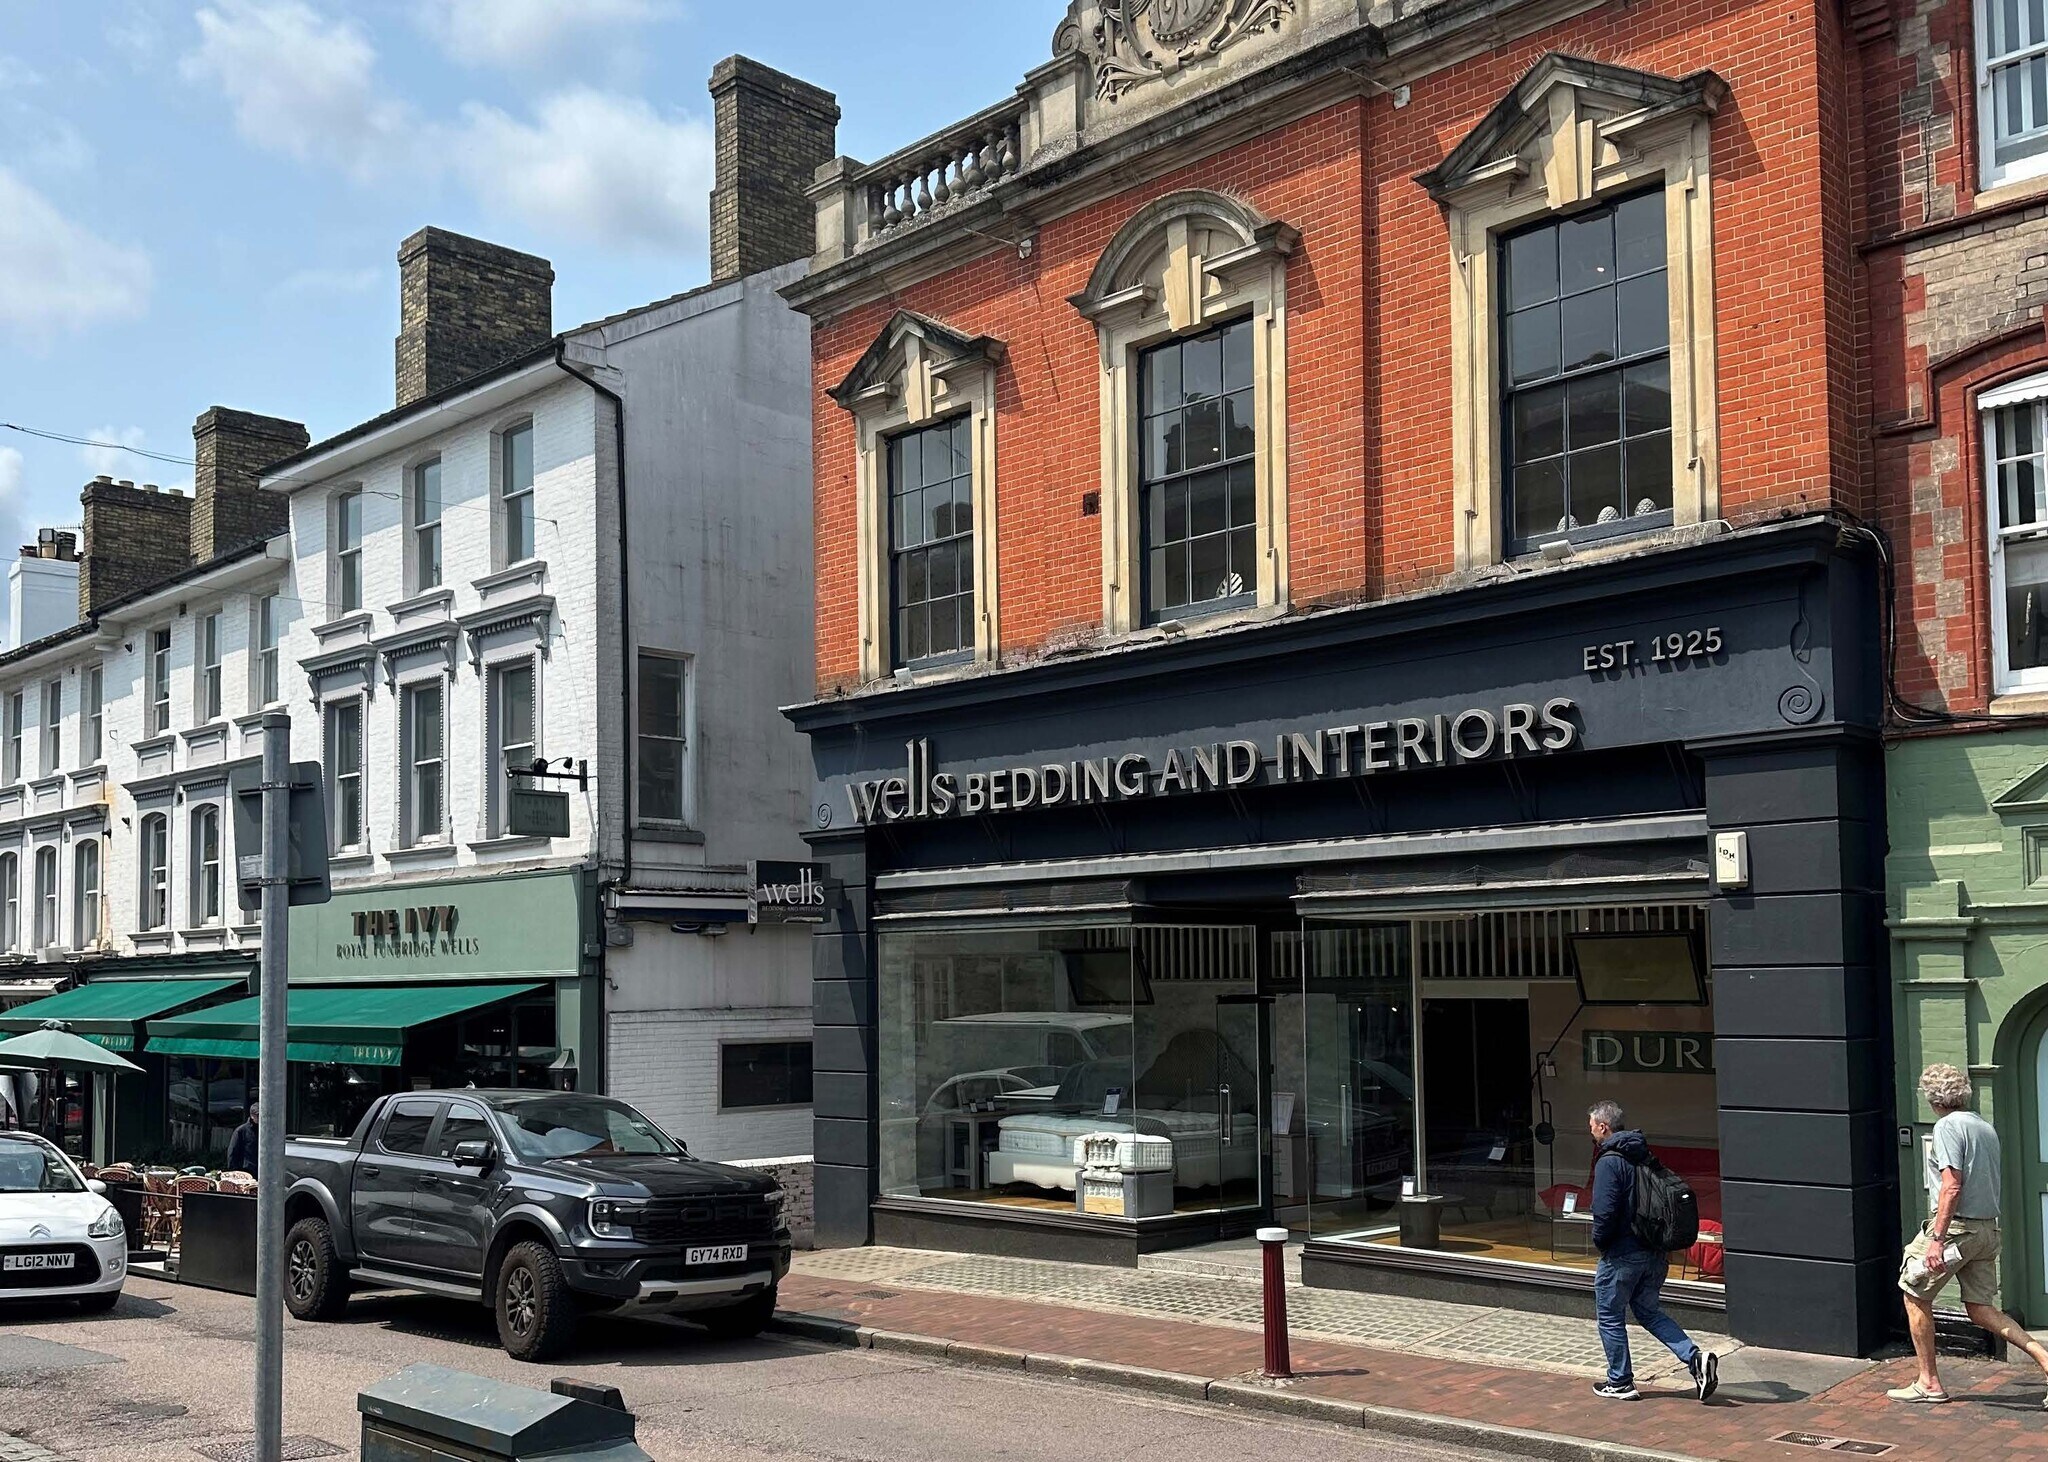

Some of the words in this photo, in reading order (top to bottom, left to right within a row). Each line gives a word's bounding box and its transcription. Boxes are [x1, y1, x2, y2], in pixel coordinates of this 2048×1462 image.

[1583, 640, 1640, 671] EST.
[1651, 627, 1722, 661] 1925
[845, 737, 955, 823] wells
[966, 752, 1146, 812] BEDDING
[1159, 740, 1261, 793] AND
[1277, 697, 1578, 780] INTERIORS
[763, 867, 825, 906] wells
[351, 909, 398, 937] THE
[405, 905, 457, 934] IVY
[336, 943, 368, 960] ROYAL
[440, 937, 480, 956] WELLS
[373, 1046, 392, 1060] IVY
[1589, 1035, 1715, 1069] DUR
[15, 1255, 44, 1268] LG12
[46, 1254, 70, 1267] NNV
[691, 1248, 720, 1262] GY74
[722, 1246, 743, 1261] RXD
